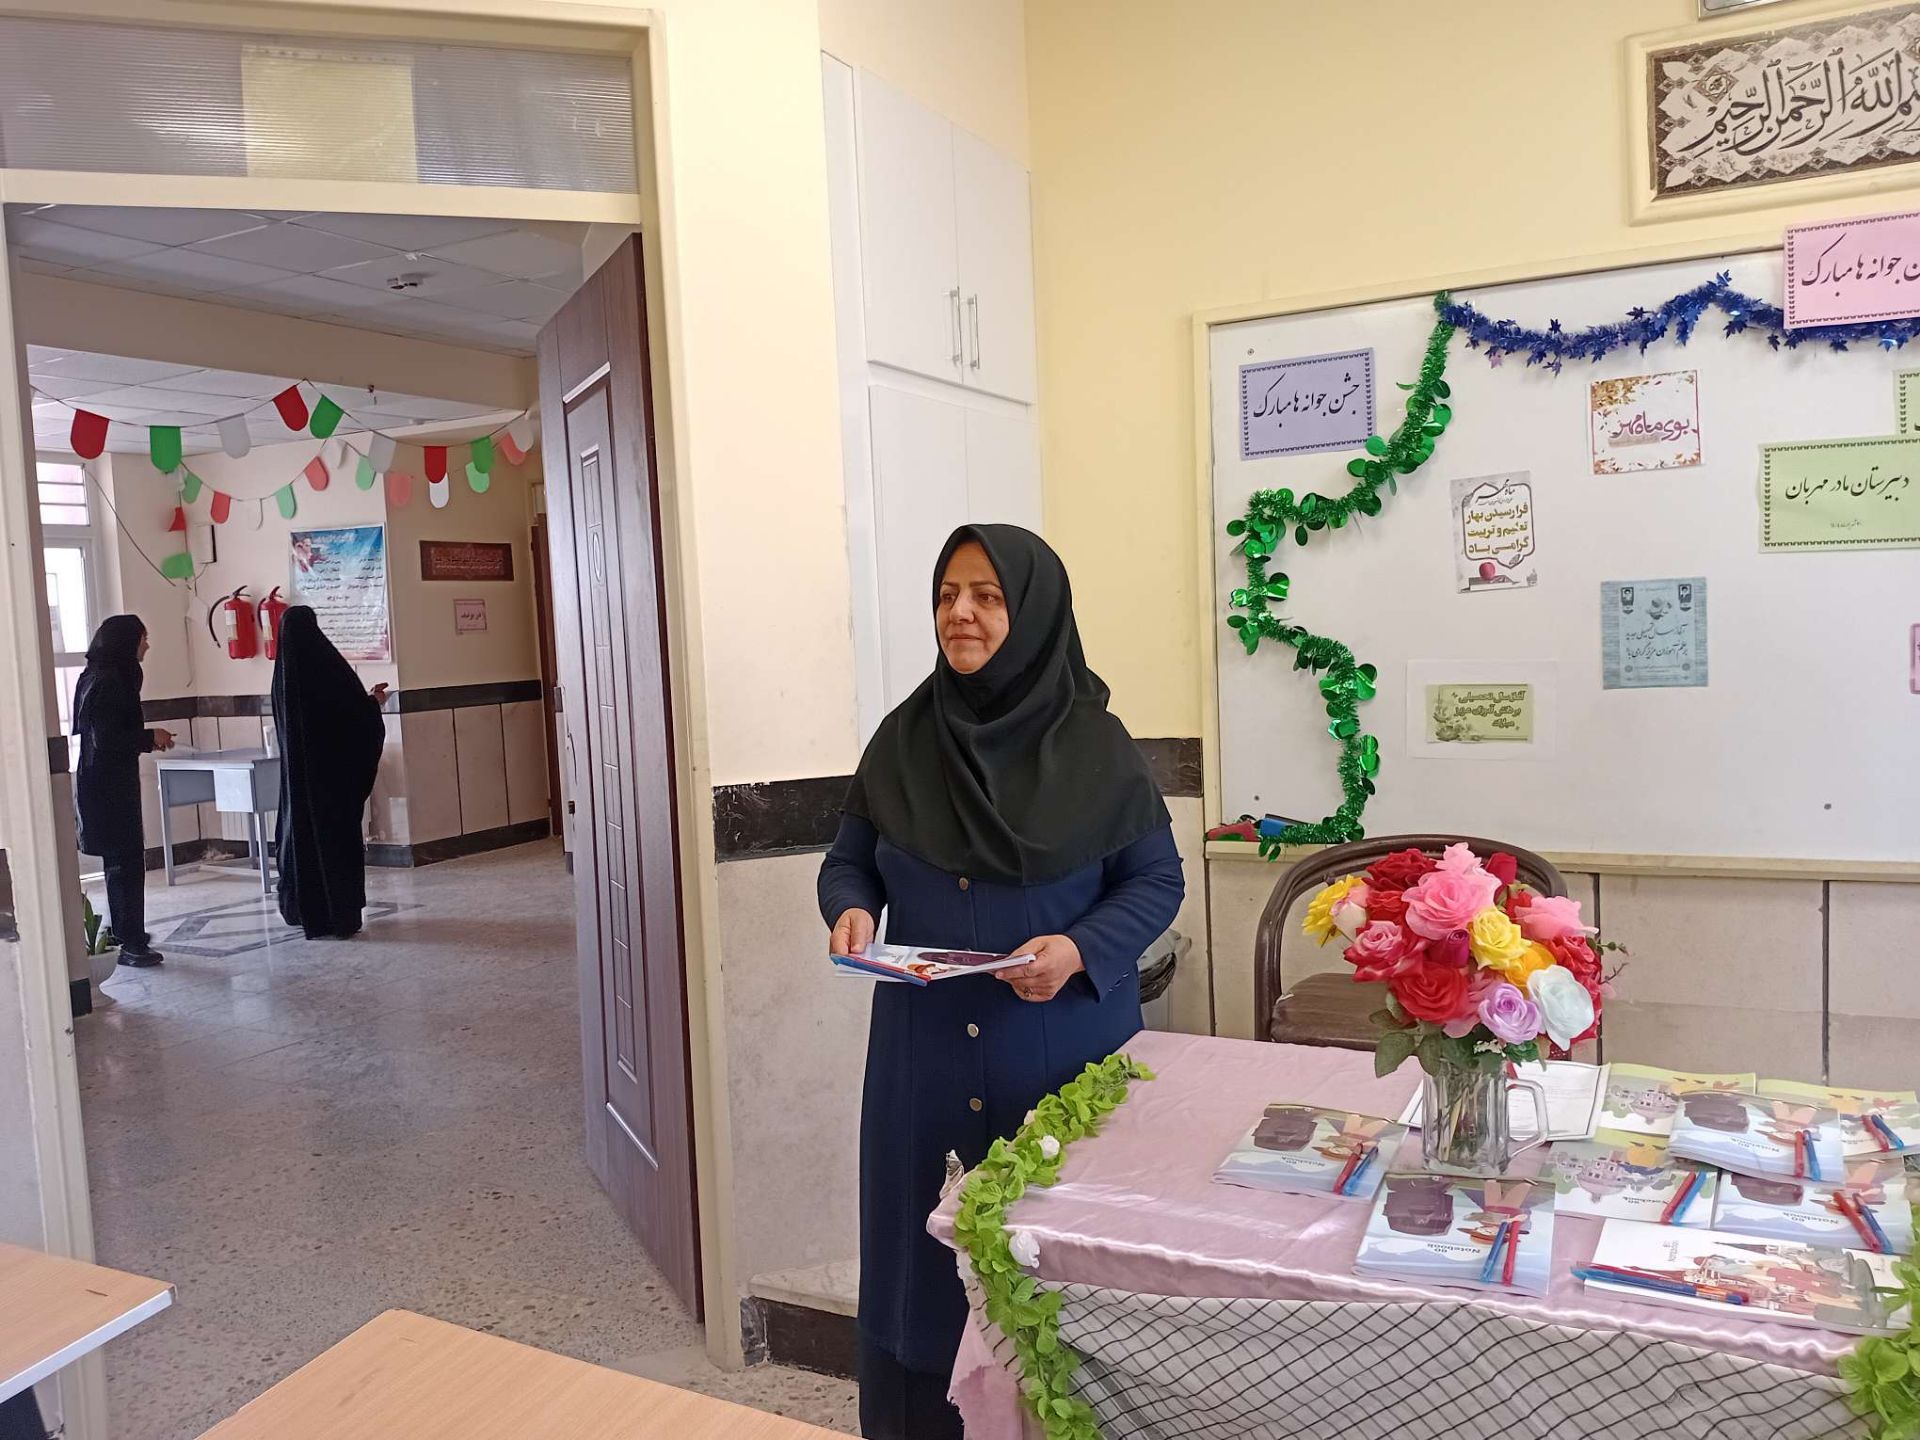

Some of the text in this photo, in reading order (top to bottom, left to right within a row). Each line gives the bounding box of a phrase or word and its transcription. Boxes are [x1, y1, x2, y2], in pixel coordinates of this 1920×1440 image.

[1801, 232, 1853, 297] مبارک
[1866, 255, 1902, 285] جوانه
[1253, 371, 1292, 428] مبارک
[1301, 391, 1328, 417] جوانه
[1328, 372, 1361, 415] جشن
[1609, 410, 1690, 441] بوی ماه مهر
[1785, 466, 1910, 504] دبیرستان مادر مهربان
[1465, 510, 1484, 524] بهار
[1467, 524, 1495, 538] تربیت
[1468, 536, 1529, 554] گرامی باد
[1496, 527, 1502, 538] و
[1427, 1243, 1481, 1254] Notebook
